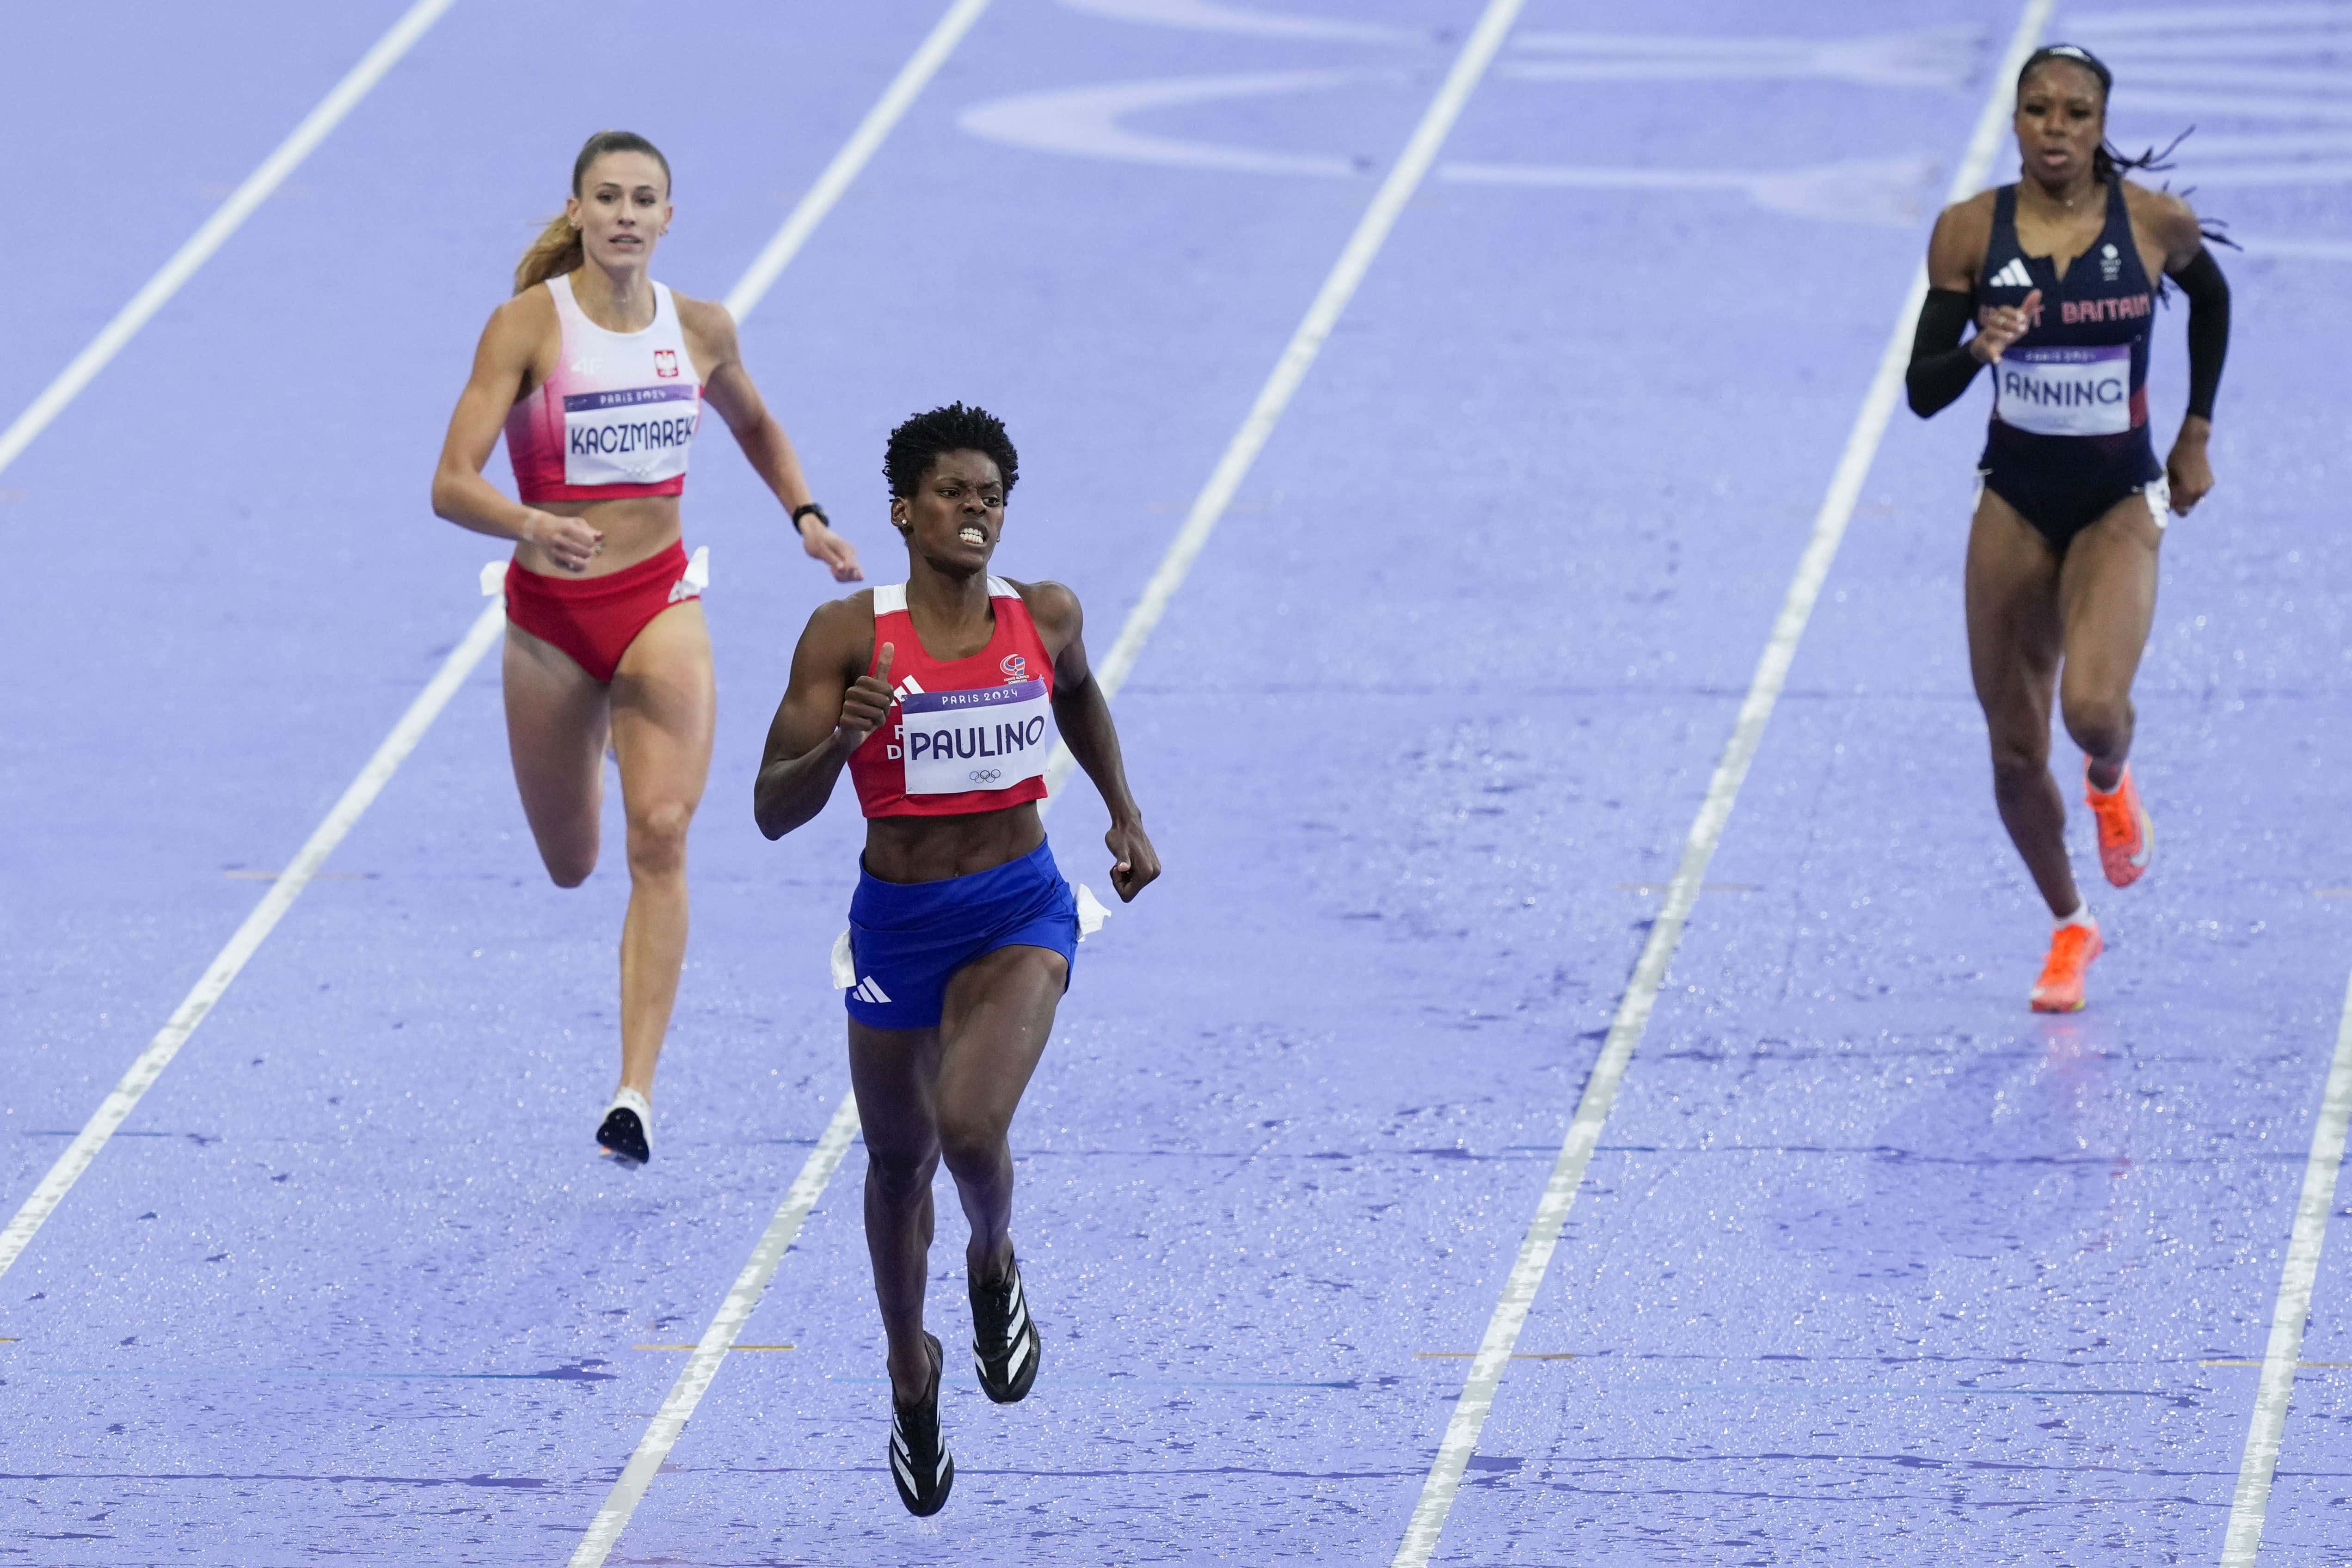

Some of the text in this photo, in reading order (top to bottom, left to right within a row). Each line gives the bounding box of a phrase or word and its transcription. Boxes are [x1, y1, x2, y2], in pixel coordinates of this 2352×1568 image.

[2061, 292, 2150, 324] BRITAIN
[2005, 370, 2123, 407] ANNING
[571, 415, 695, 454] KACZMAREK
[942, 689, 1018, 705] PARIS 2024
[910, 716, 1044, 760] PAULINO
